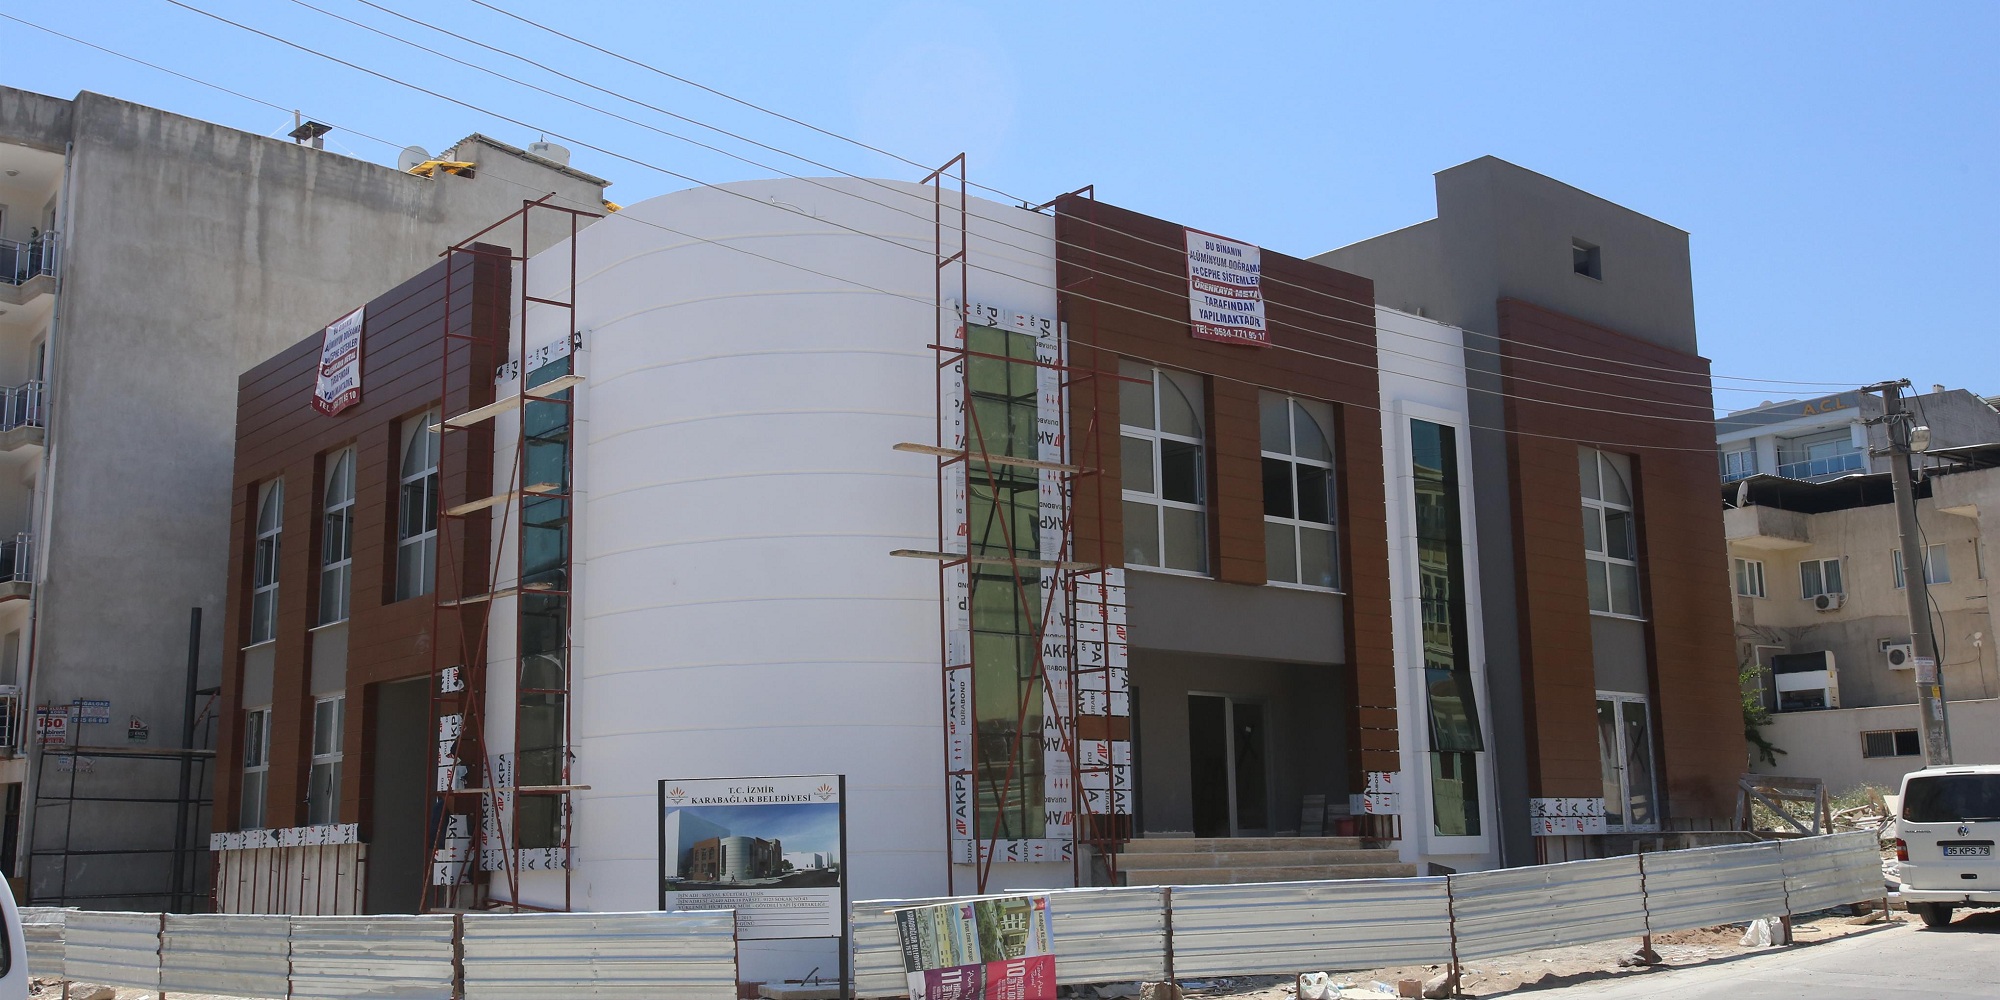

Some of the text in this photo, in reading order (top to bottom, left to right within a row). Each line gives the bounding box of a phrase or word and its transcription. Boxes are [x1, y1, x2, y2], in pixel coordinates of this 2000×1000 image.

[1206, 241, 1242, 257] BU BİNANIN
[1200, 267, 1220, 280] CEPHE
[1205, 296, 1255, 312] TARAFINDAN
[747, 785, 774, 794] İZMİR
[956, 768, 966, 818] AKPA
[691, 795, 755, 804] KARABAĞLAR
[757, 793, 811, 803] BELEDİYESİ
[1007, 960, 1026, 977] 10
[941, 969, 962, 984] 11
